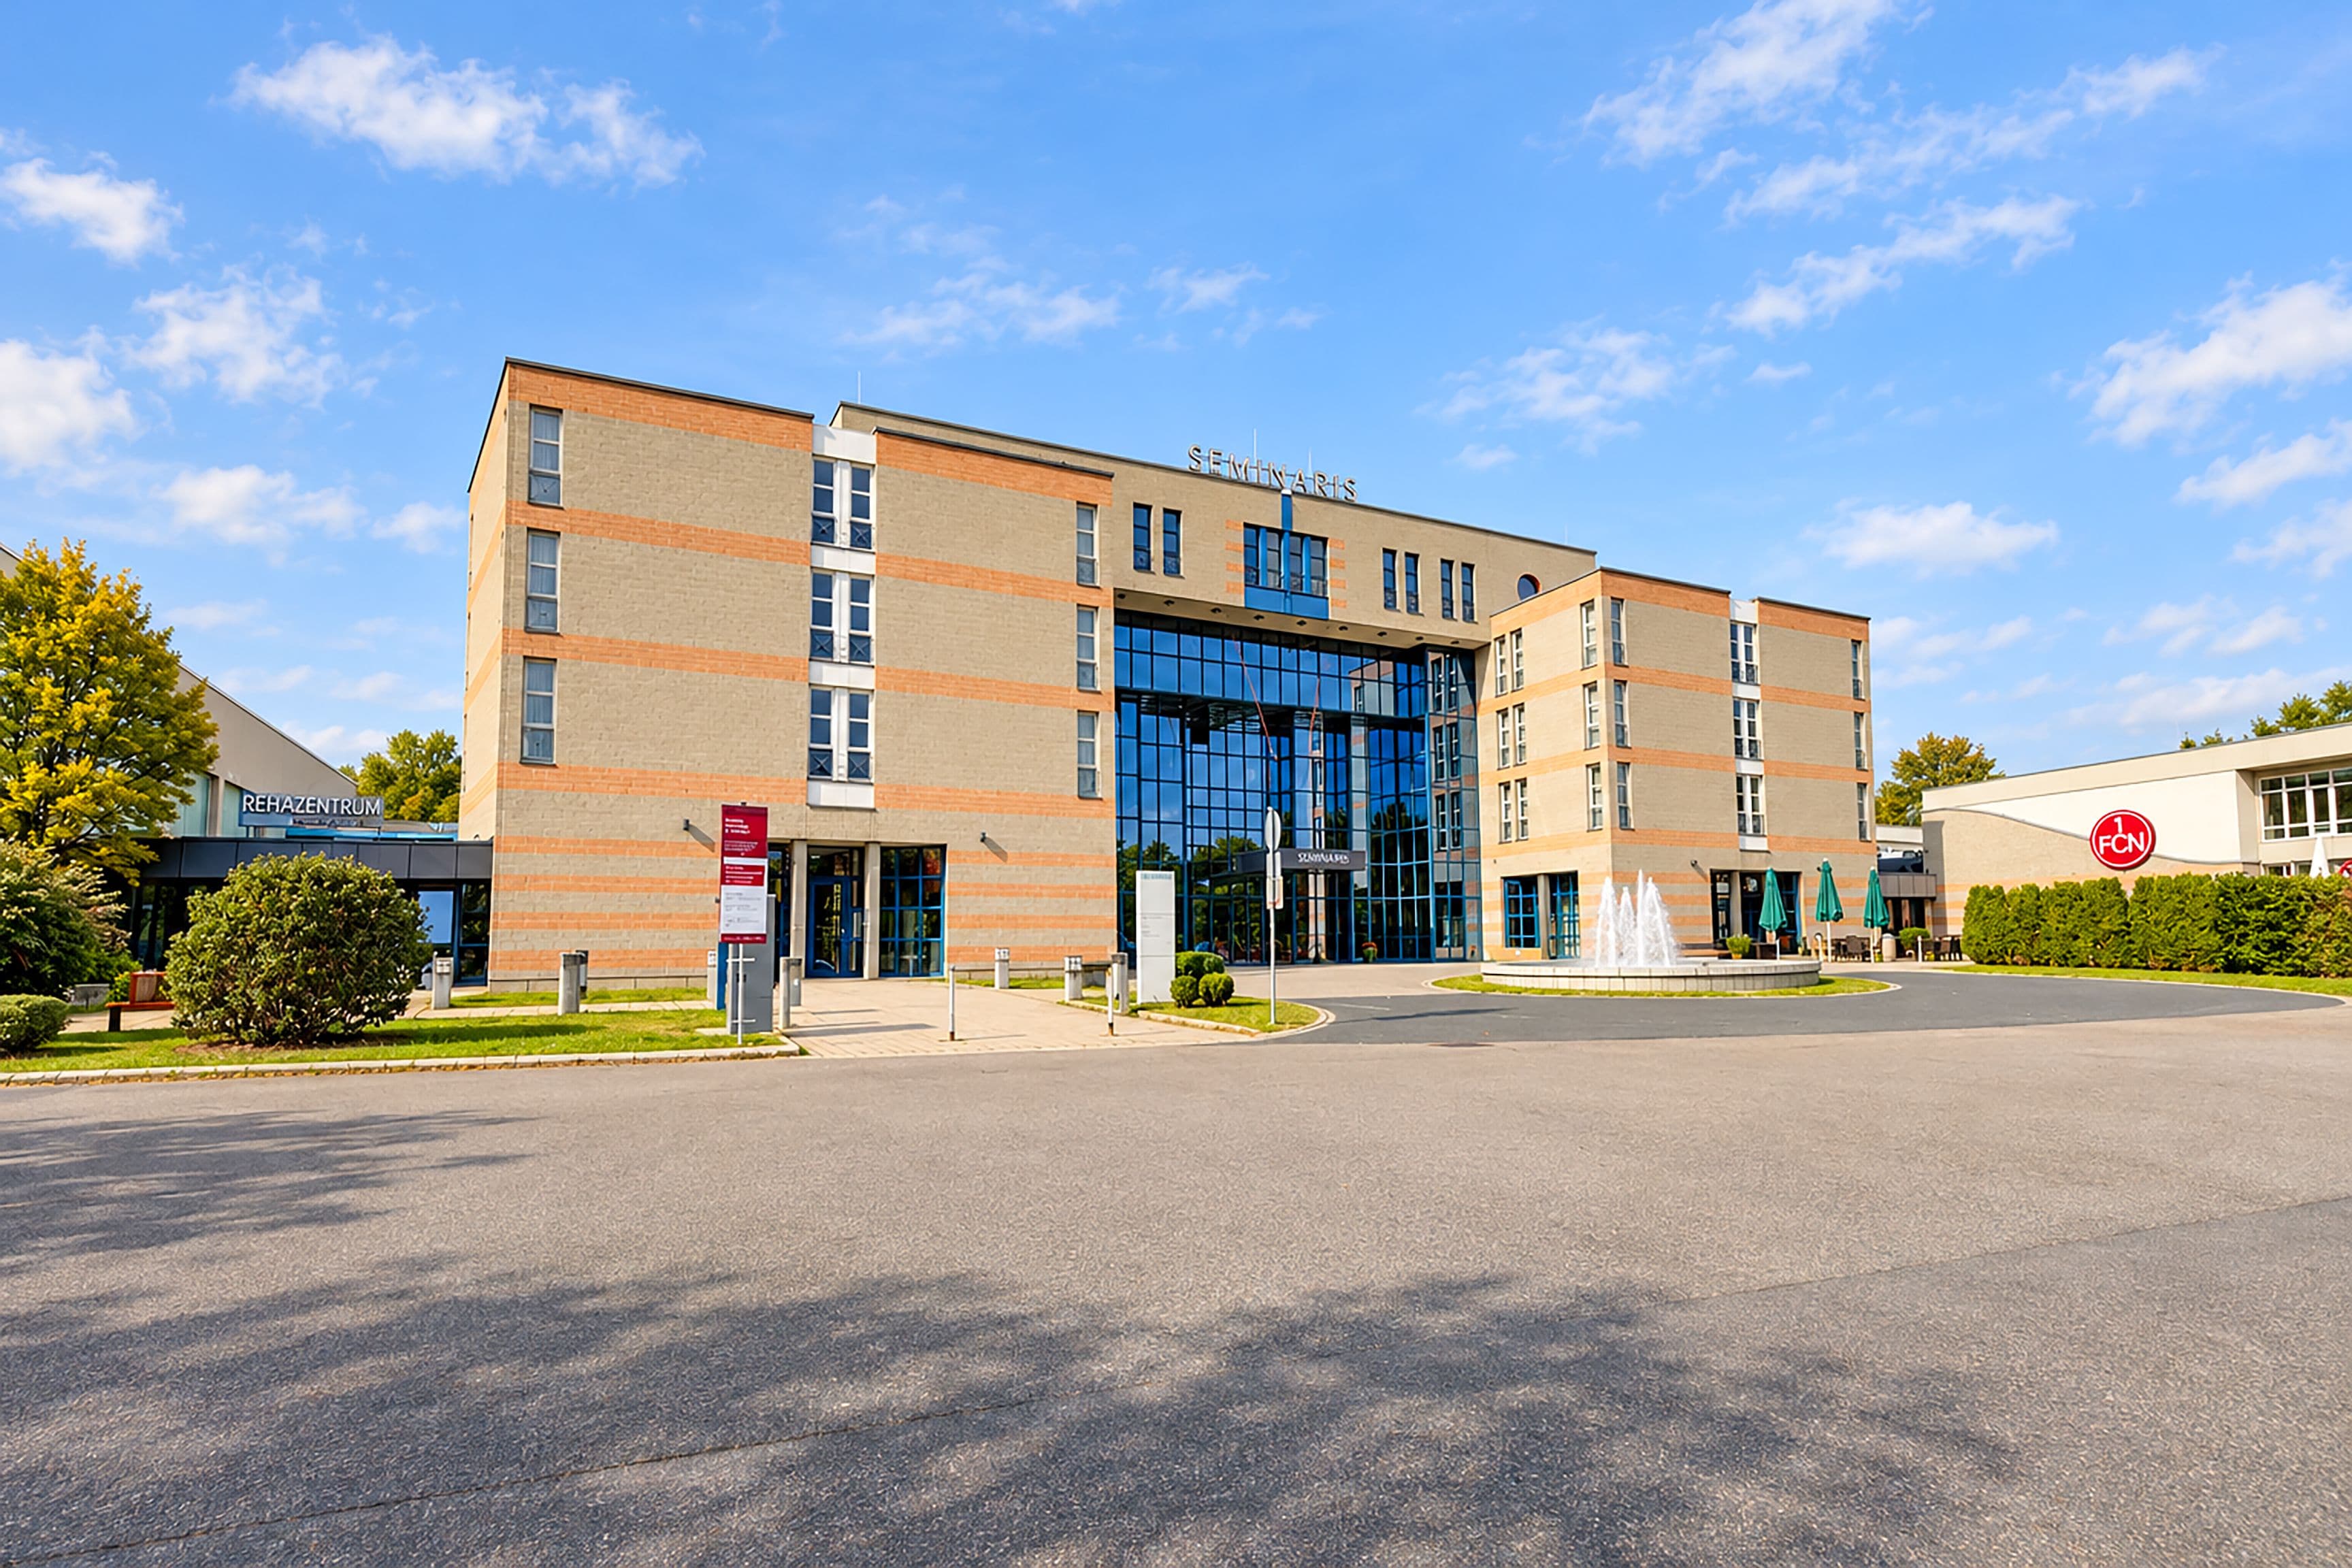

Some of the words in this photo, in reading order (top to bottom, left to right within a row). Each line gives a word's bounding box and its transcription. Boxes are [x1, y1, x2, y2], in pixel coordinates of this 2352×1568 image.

[1188, 444, 1358, 502] SEMINARIS
[242, 794, 380, 815] REHAZENTRUM
[2114, 816, 2123, 834] 1
[2099, 832, 2144, 855] FCN
